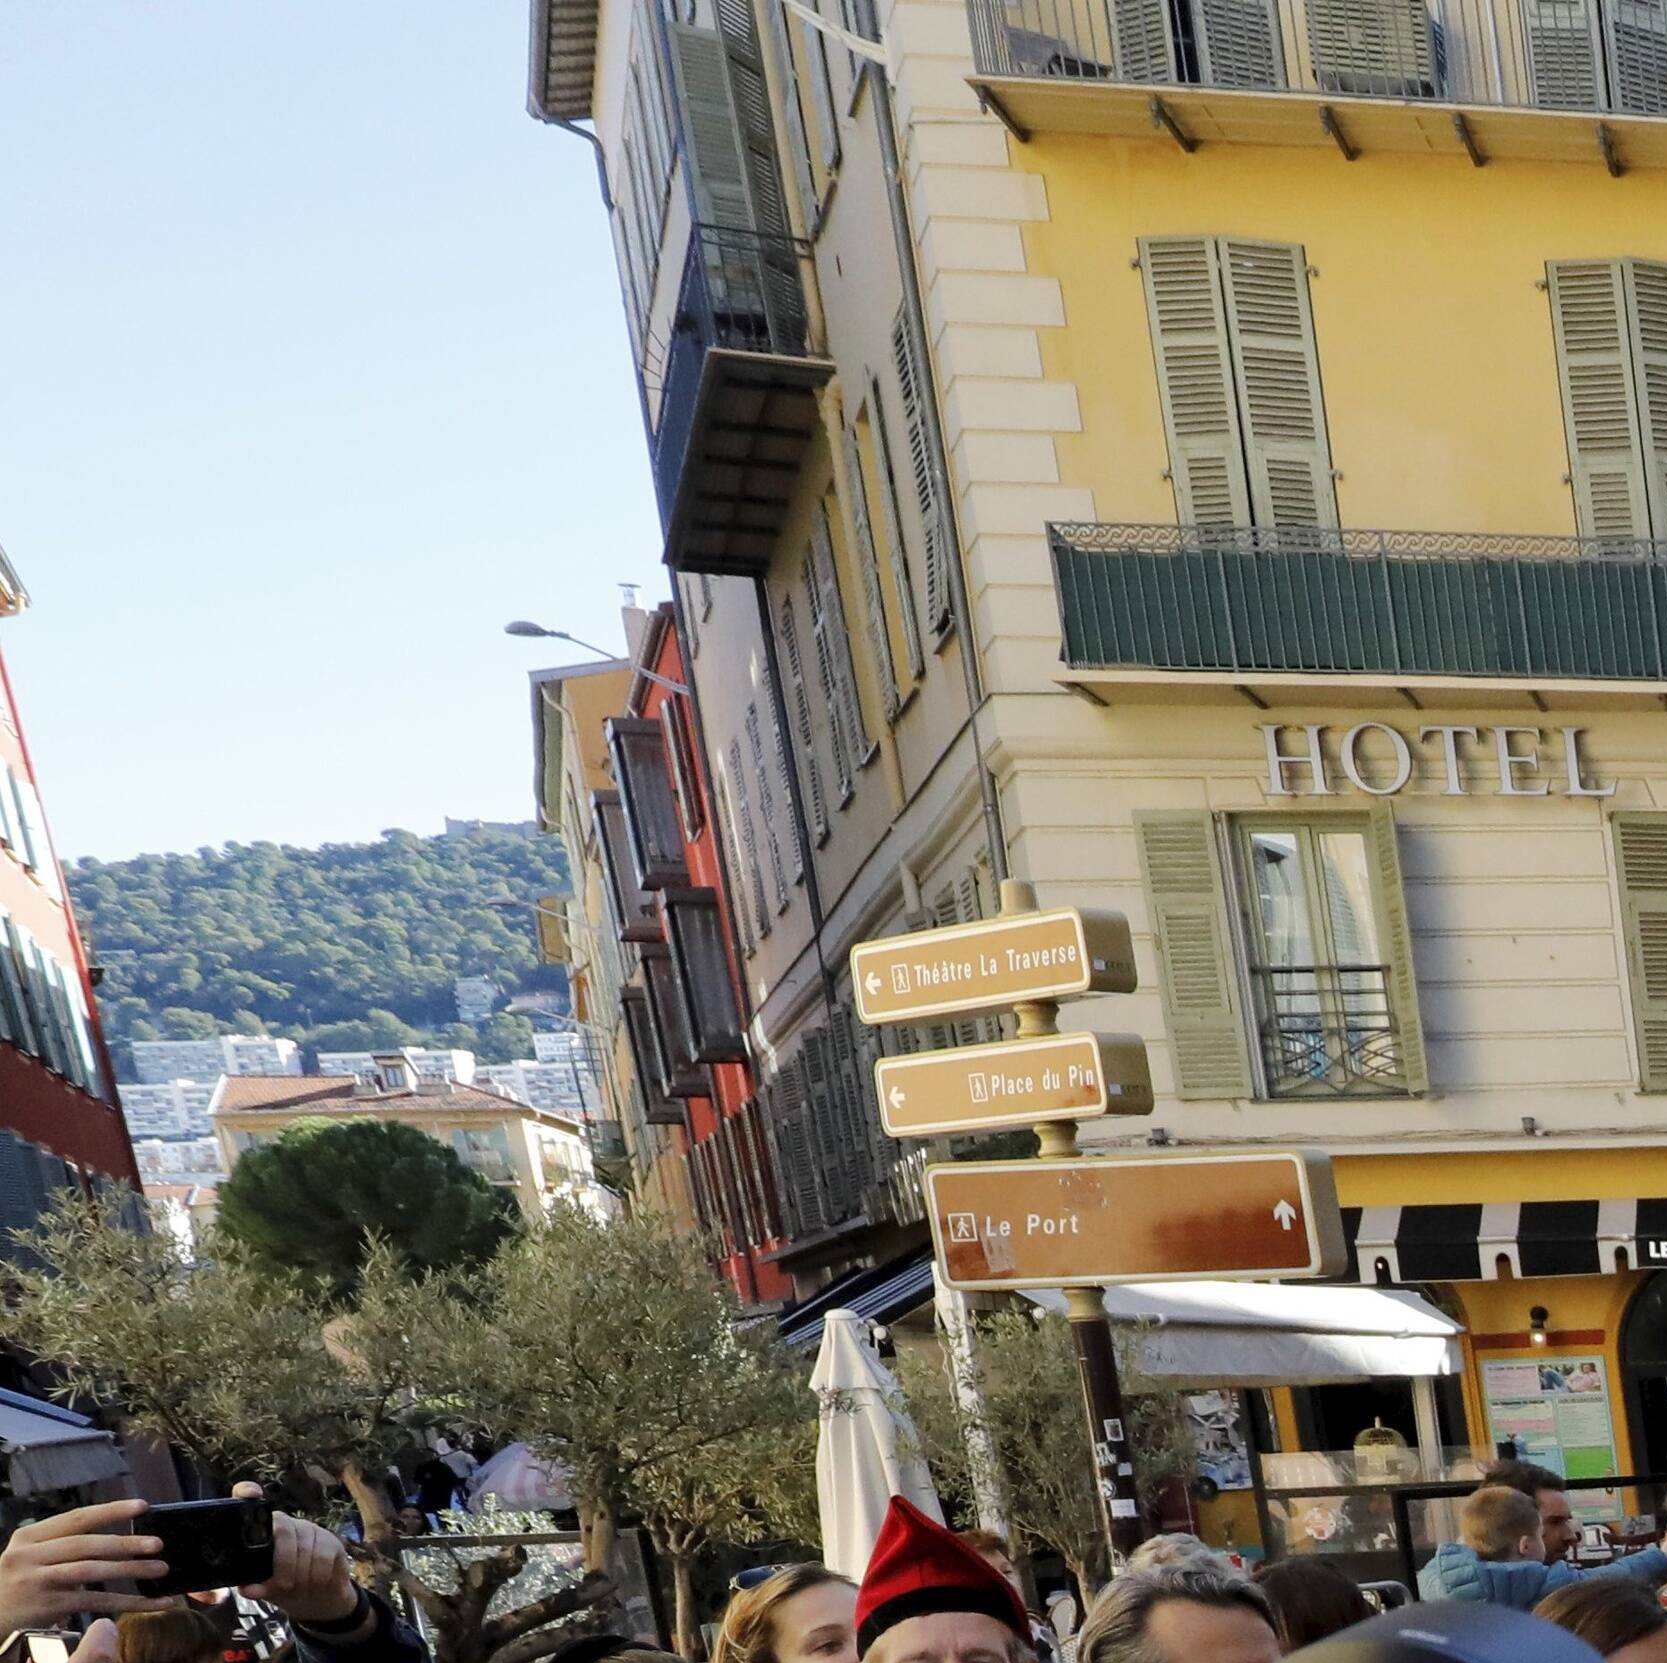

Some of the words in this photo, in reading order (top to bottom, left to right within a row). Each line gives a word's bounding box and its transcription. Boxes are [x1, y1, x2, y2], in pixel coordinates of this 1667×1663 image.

[1254, 721, 1618, 796] HOTEL
[914, 962, 972, 988] Théâtre
[980, 954, 998, 977] La
[1006, 944, 1076, 973] Traverse
[991, 1074, 1033, 1097] Place
[1043, 1068, 1061, 1090] du
[1068, 1064, 1095, 1087] Pin
[985, 1215, 1011, 1237] Le
[1026, 1213, 1079, 1235] Port
